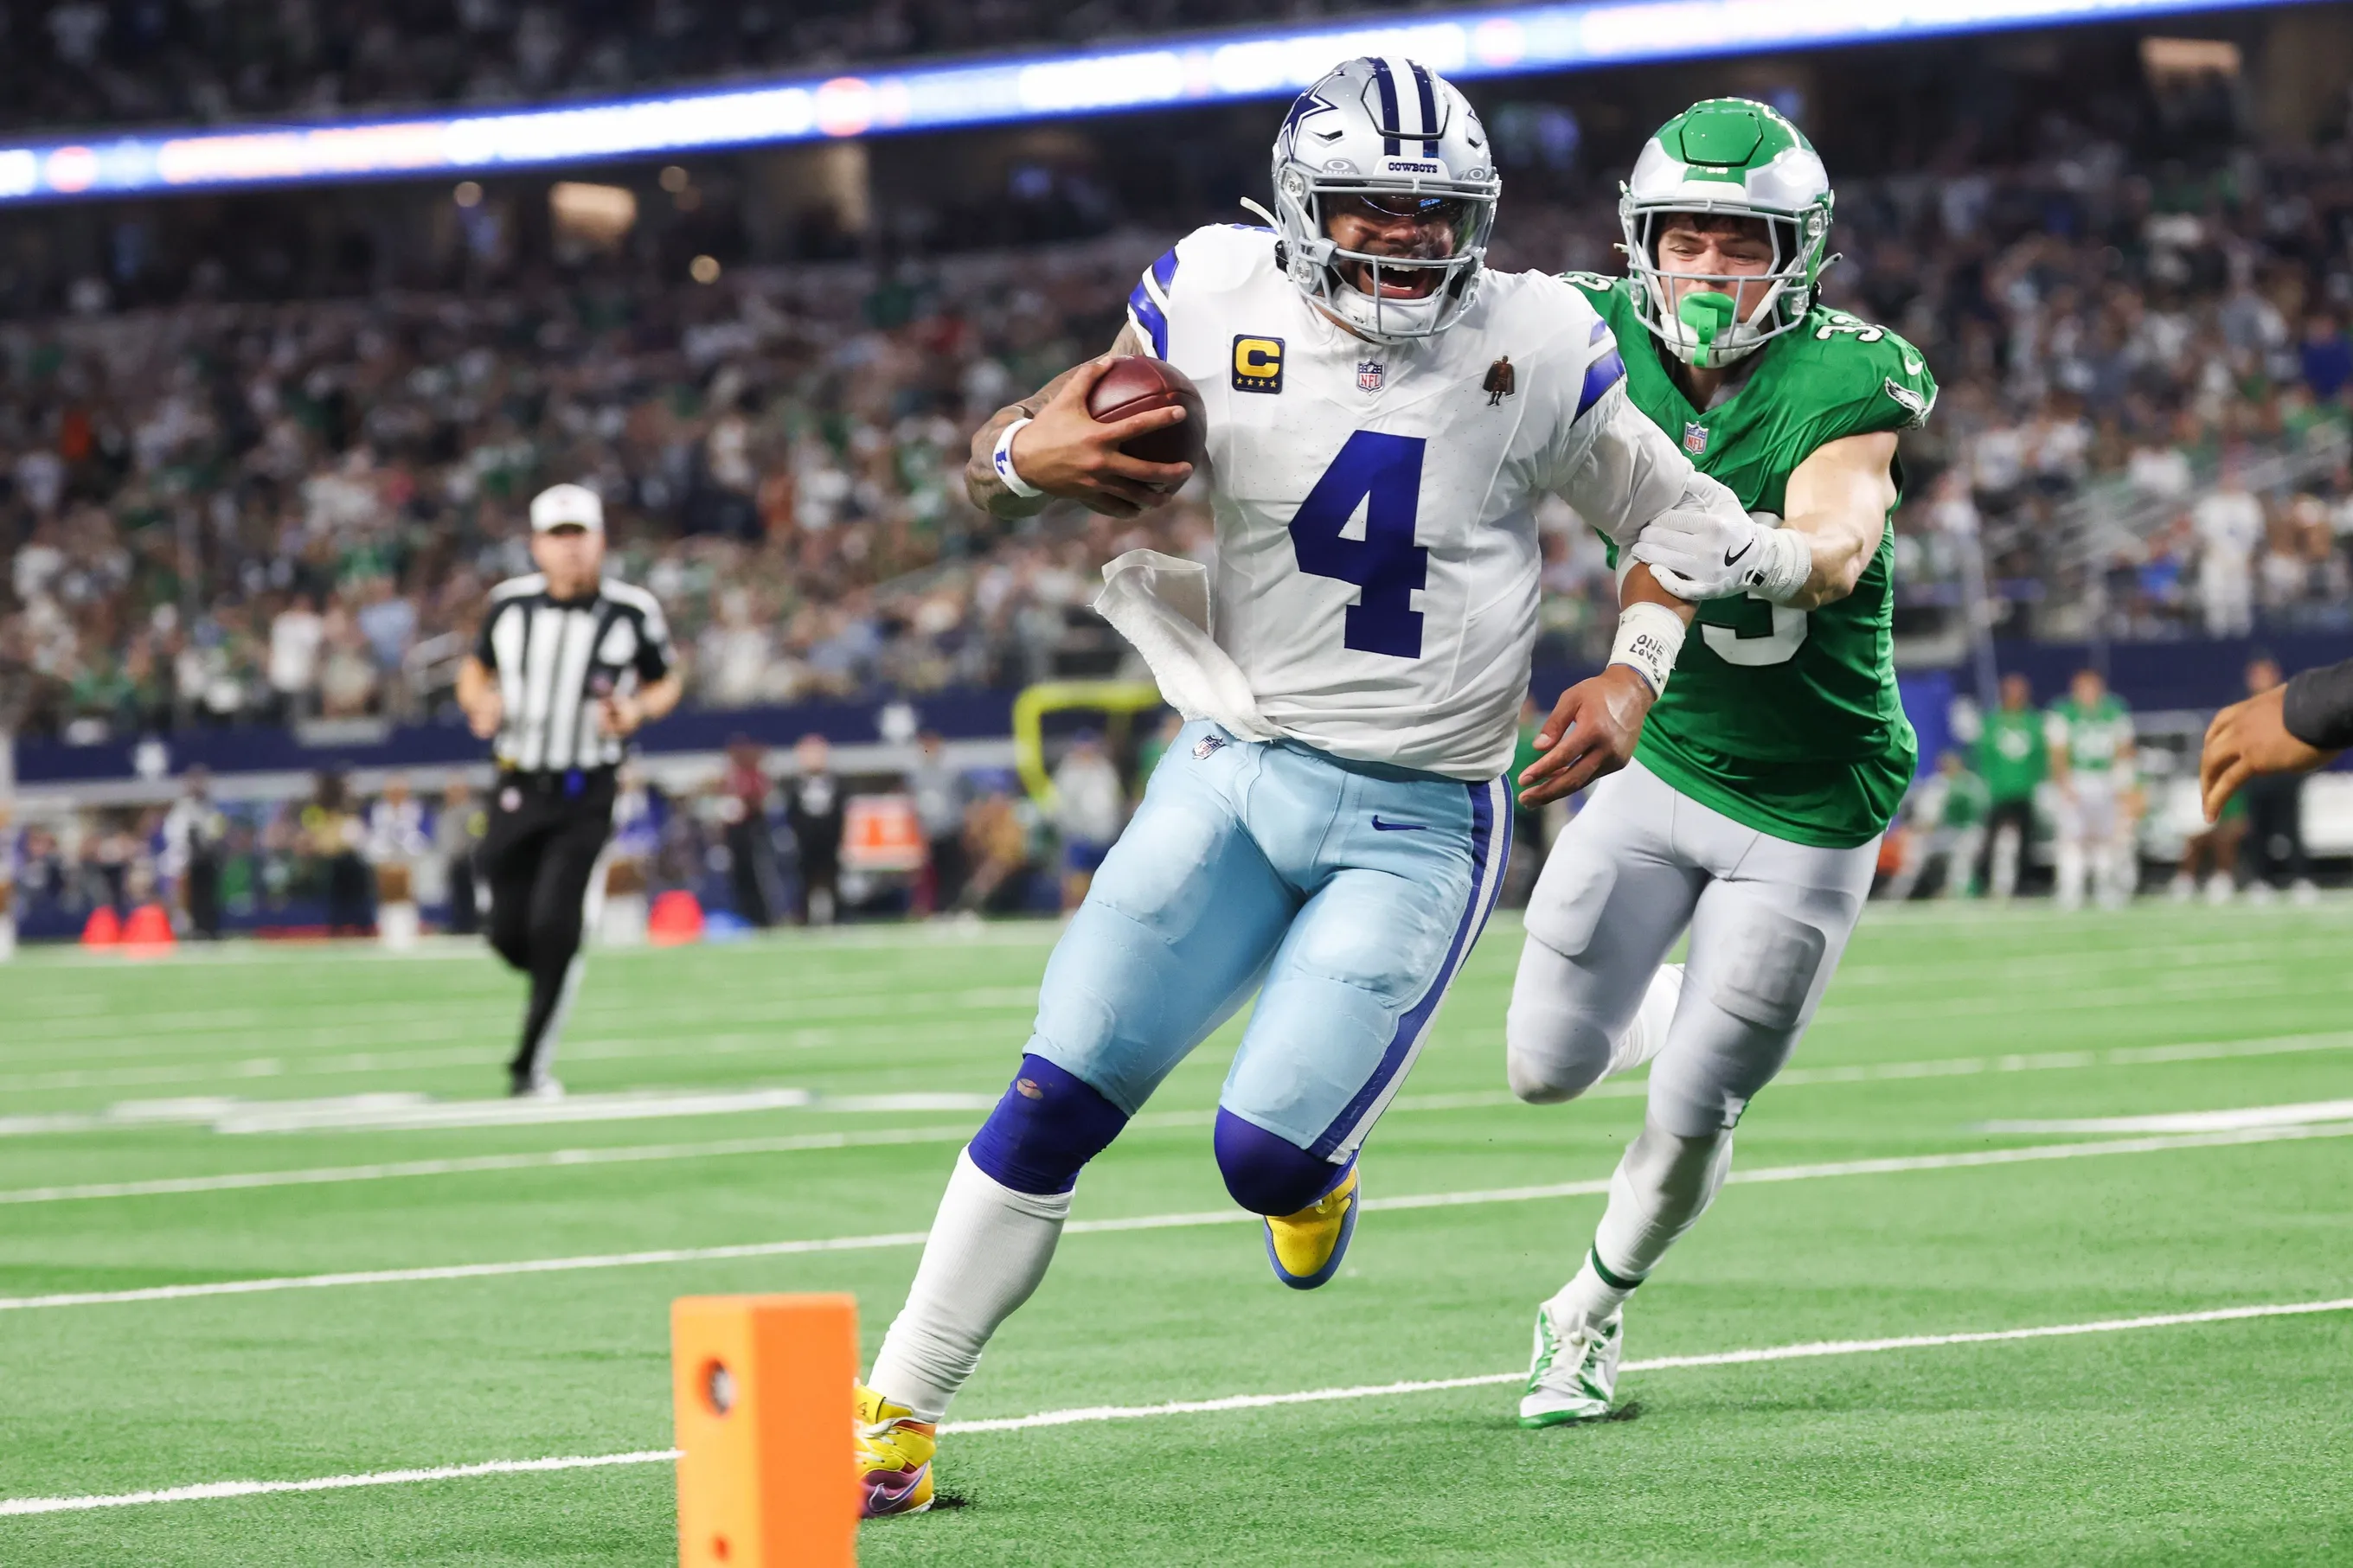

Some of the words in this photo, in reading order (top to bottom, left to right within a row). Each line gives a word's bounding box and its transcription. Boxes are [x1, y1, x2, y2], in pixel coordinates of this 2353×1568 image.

[1388, 162, 1438, 174] COWBOYS
[1235, 338, 1281, 378] C
[1361, 374, 1381, 388] NFL
[1687, 435, 1703, 451] NFL
[1288, 429, 1428, 659] 4
[1629, 643, 1658, 668] LOVE
[1637, 634, 1665, 657] ONE
